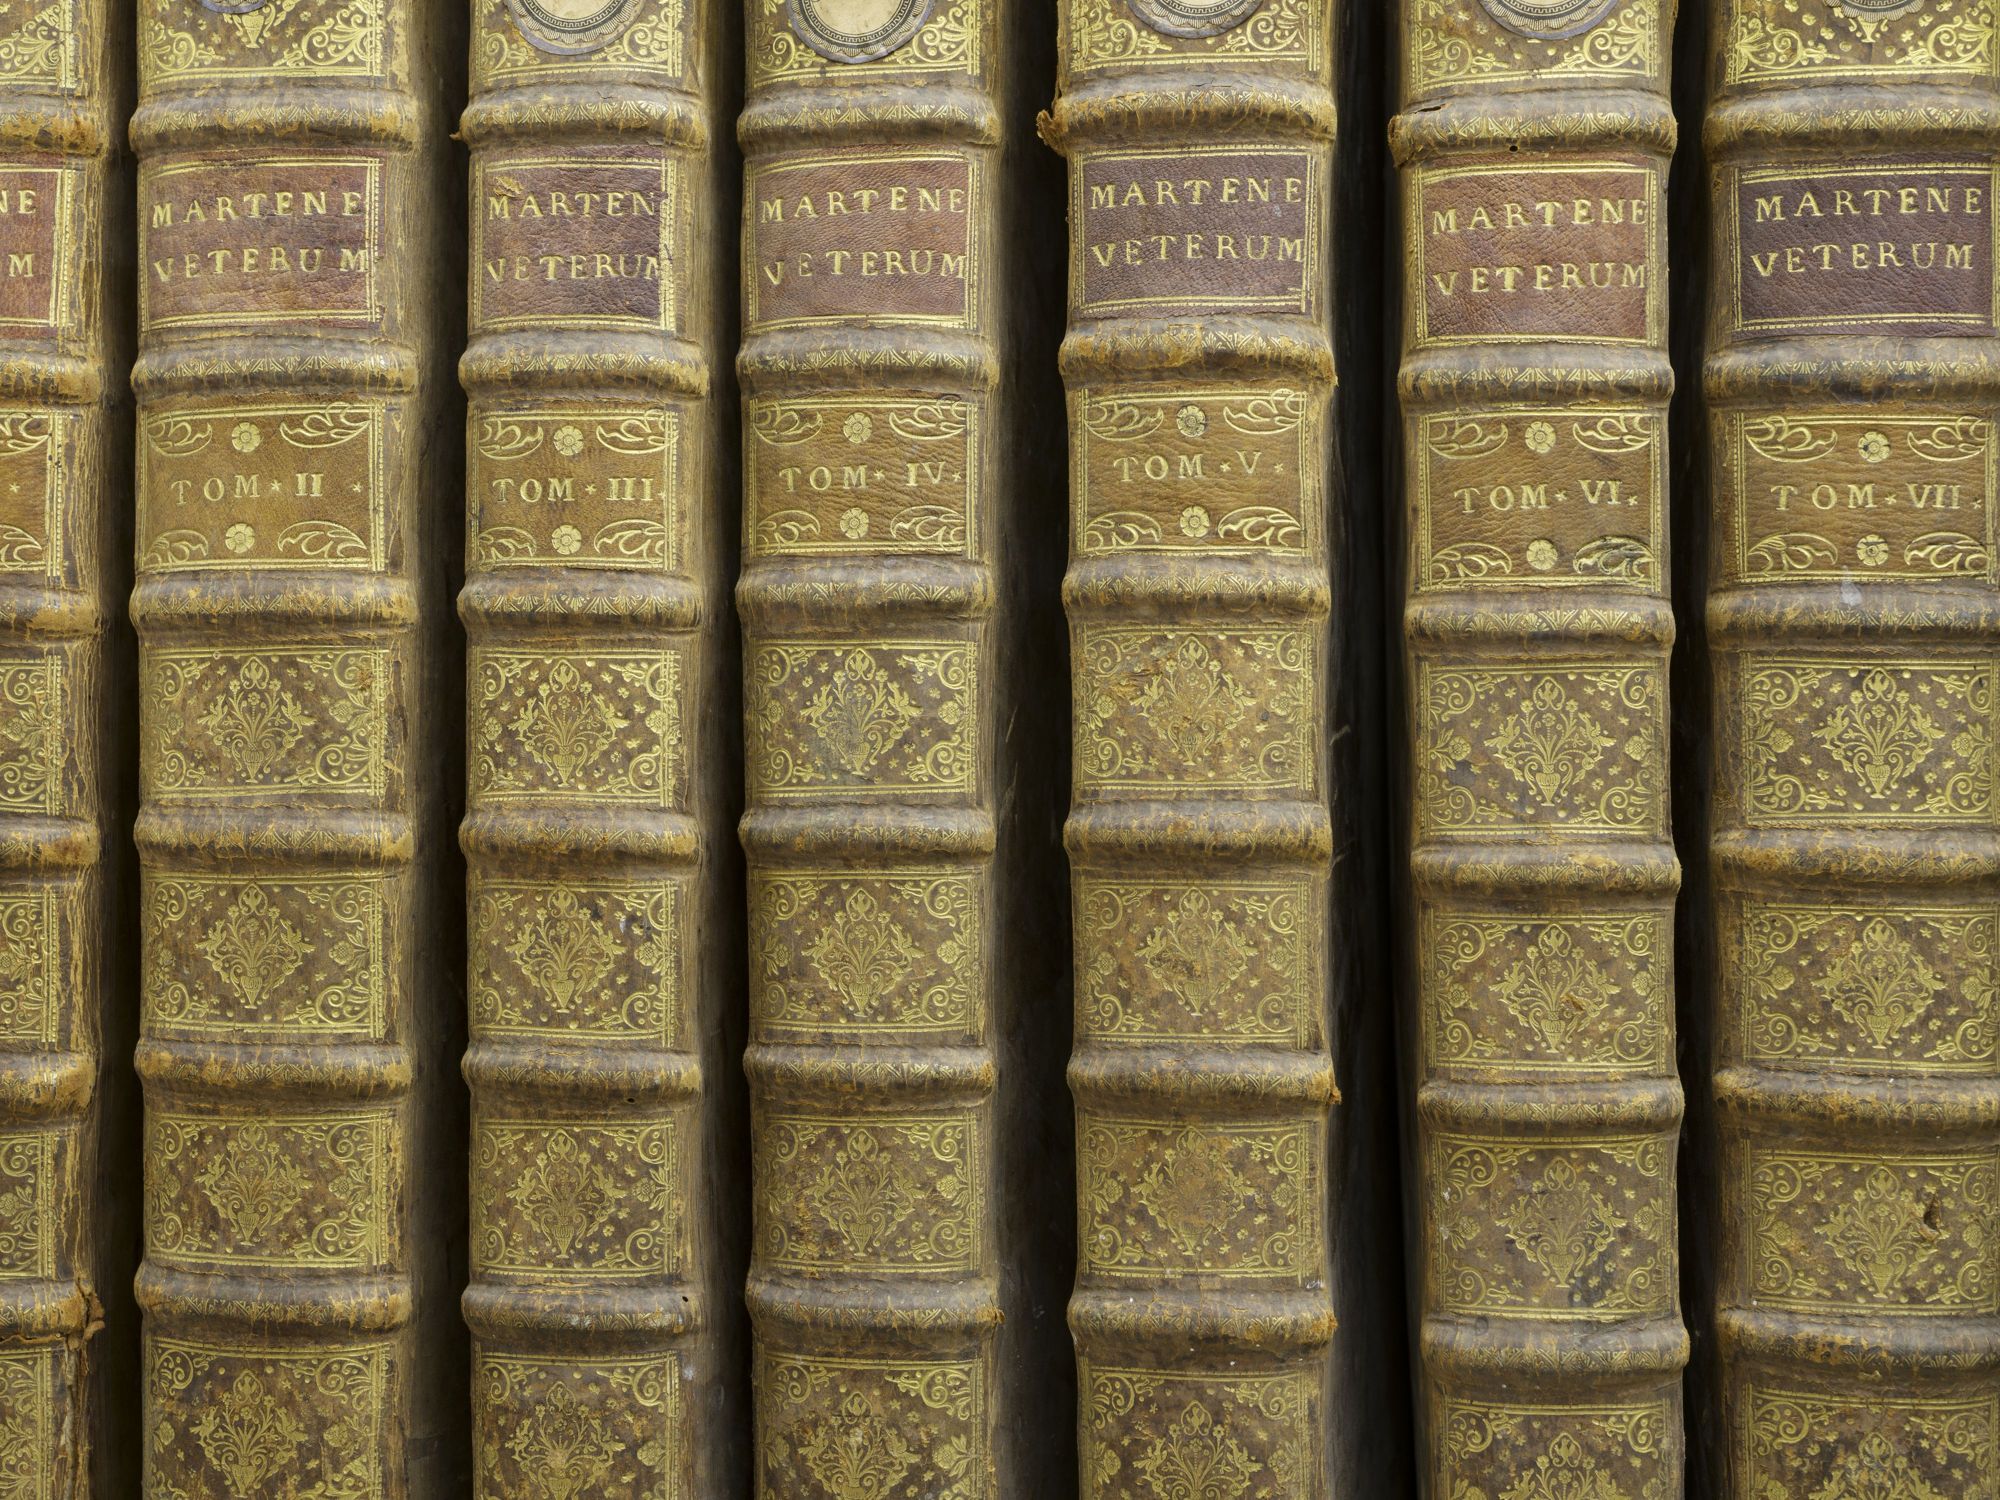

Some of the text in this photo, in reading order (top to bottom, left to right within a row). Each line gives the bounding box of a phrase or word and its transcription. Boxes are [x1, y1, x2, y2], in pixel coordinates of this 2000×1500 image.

[761, 186, 965, 223] MARTENE
[1091, 177, 1302, 209] MARTENE
[1755, 187, 1982, 222] MARTENE
[152, 191, 365, 229] MARTENE
[1432, 199, 1648, 235] MARTENE
[153, 247, 368, 282] VETERUM
[1091, 234, 1305, 267] VETERUM
[1750, 242, 1974, 277] VETERUM
[763, 250, 966, 286] VETERUM
[1433, 262, 1646, 295] VETERUM
[779, 461, 946, 492] TOM IV
[1113, 450, 1262, 482] TOM V
[171, 473, 324, 505] TOM II
[492, 477, 654, 502] TOM III
[1454, 480, 1622, 513] TOM VI
[1770, 483, 1961, 511] TOM VII
